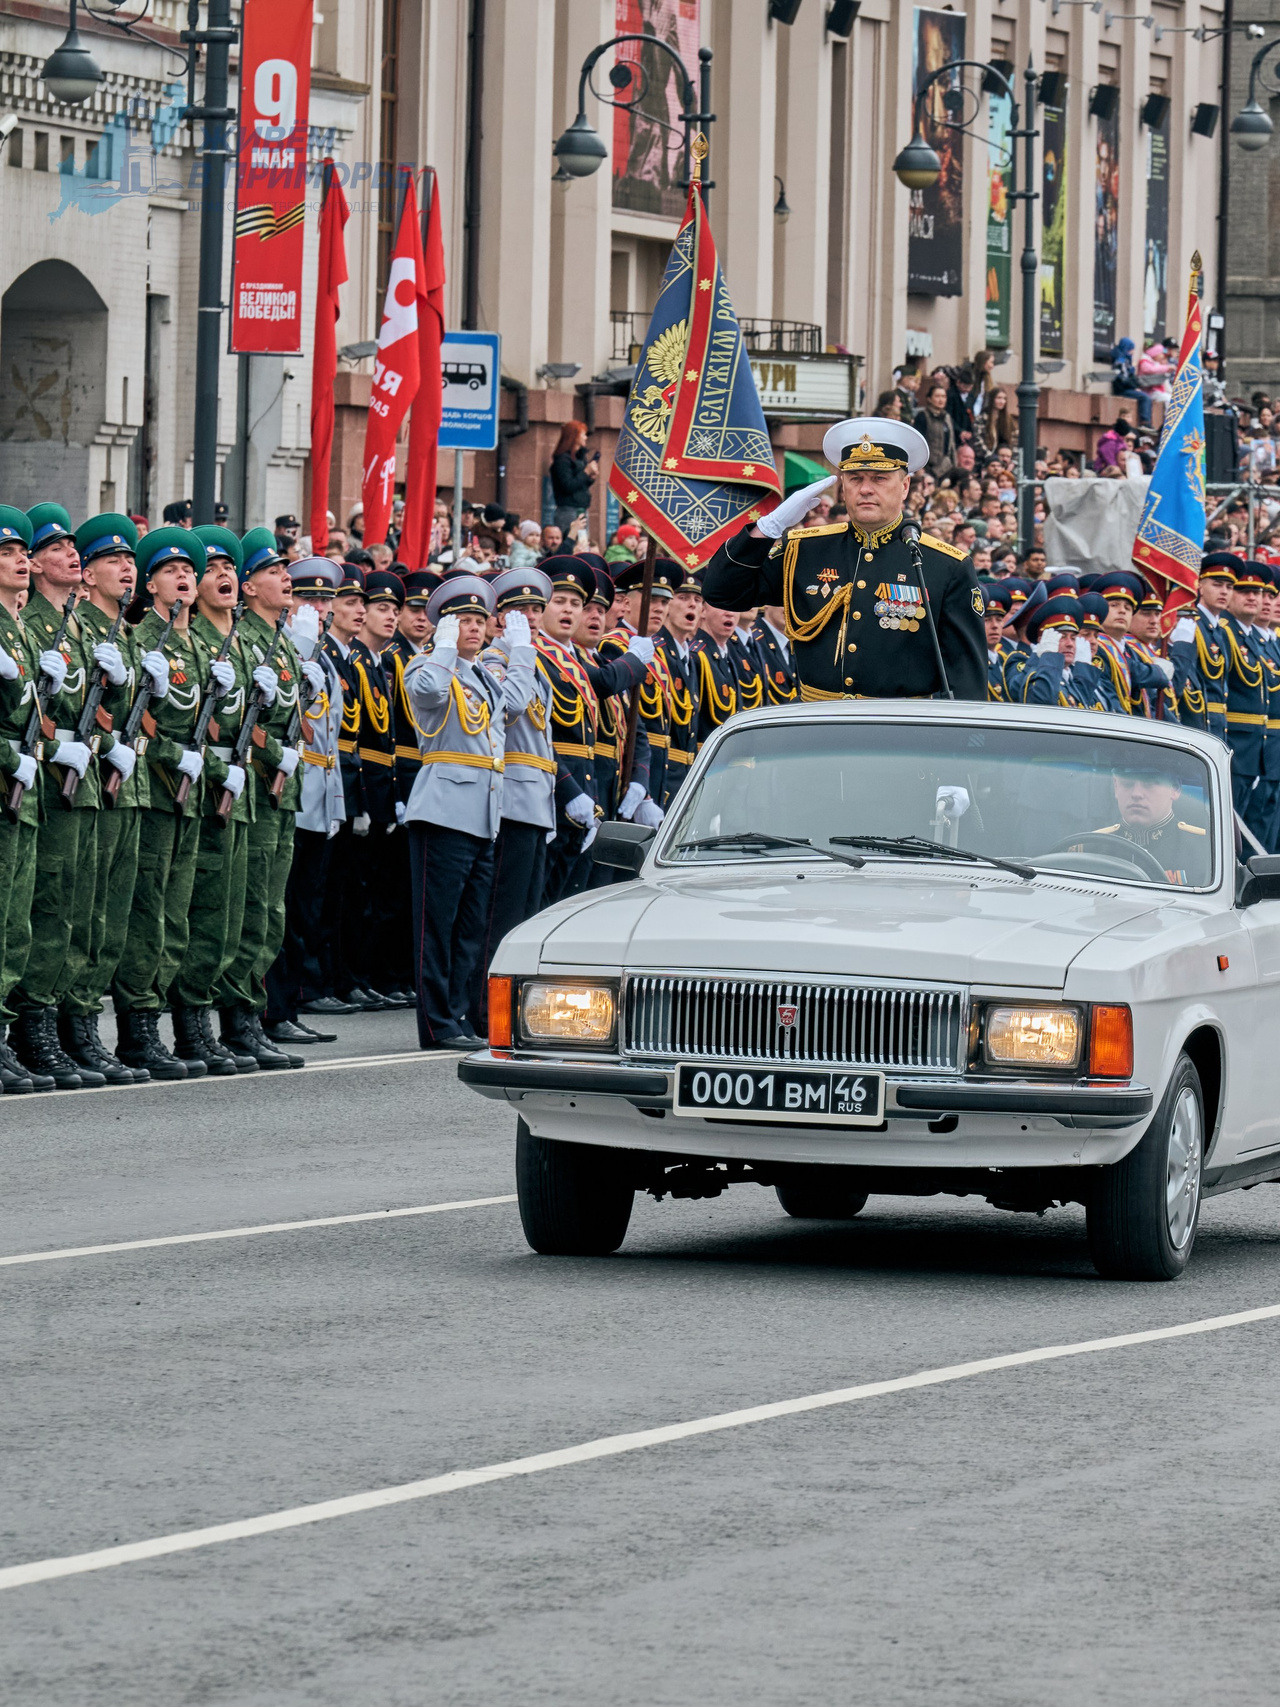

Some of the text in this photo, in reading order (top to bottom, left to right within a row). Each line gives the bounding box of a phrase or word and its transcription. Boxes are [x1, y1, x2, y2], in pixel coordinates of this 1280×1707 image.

[254, 59, 298, 142] 9
[252, 147, 295, 169] МАЯ
[240, 290, 296, 306] ВЕЛИКОЙ
[239, 304, 296, 322] ПОБЕДЫ!
[750, 361, 797, 392] УРИ
[369, 395, 390, 418] 945
[442, 411, 461, 419] ЩАДЬ
[691, 1071, 775, 1107] 0001
[833, 1077, 867, 1102] 46
[837, 1102, 862, 1113] RUS
